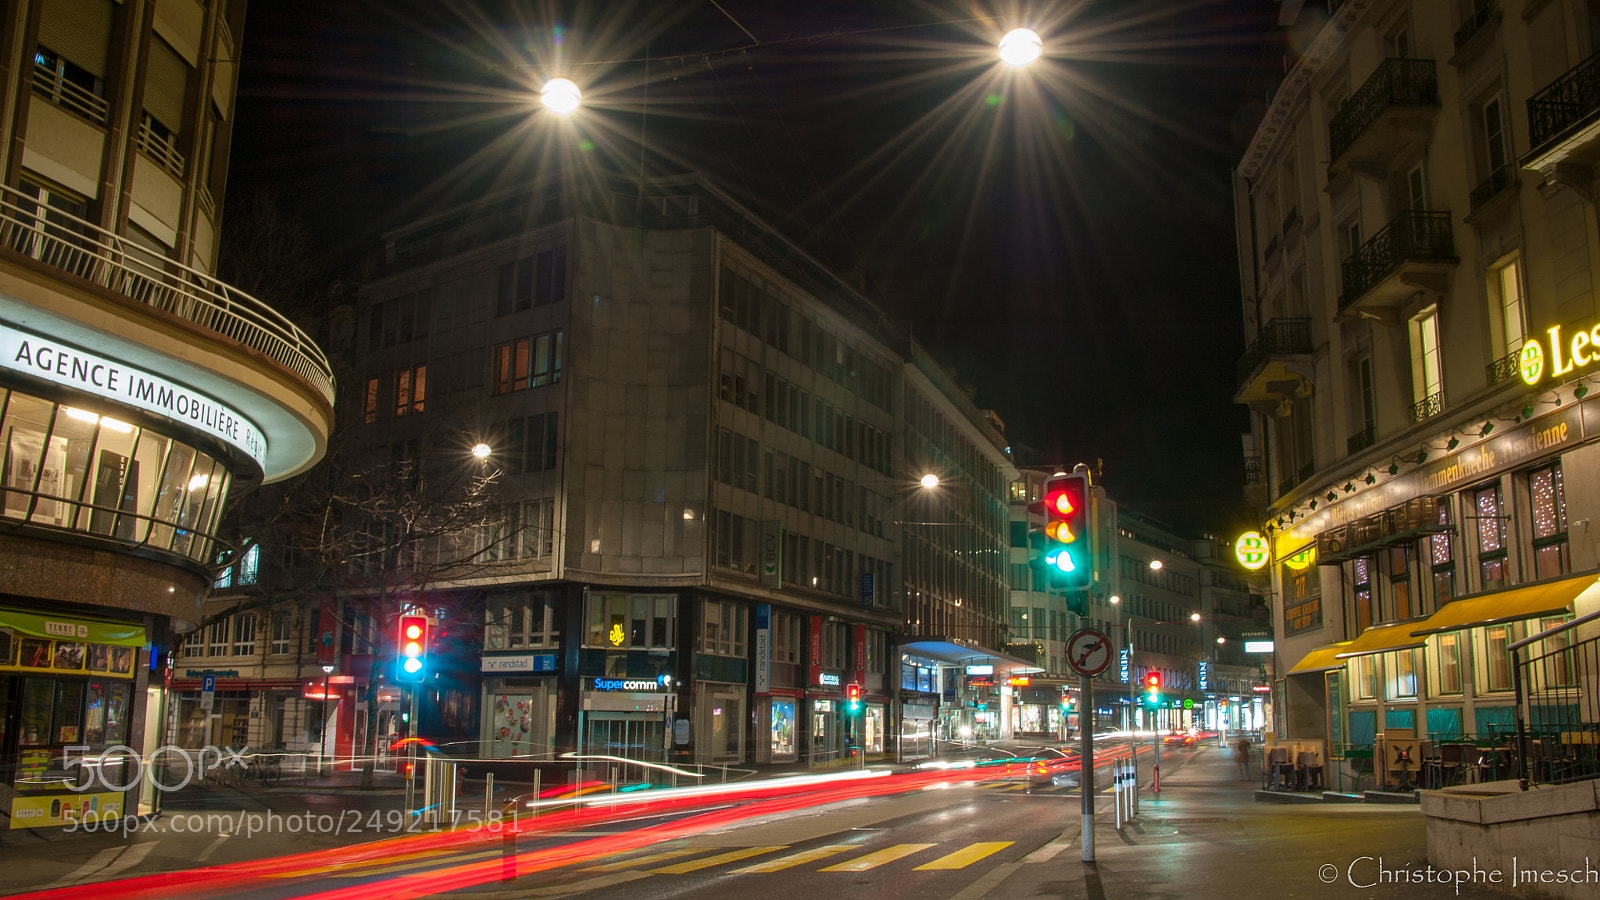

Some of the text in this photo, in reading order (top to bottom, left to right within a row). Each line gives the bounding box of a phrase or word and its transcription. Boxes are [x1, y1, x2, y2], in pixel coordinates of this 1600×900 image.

[15, 340, 119, 392] AGENCE
[128, 374, 239, 441] IMMOBILIÈRE
[1499, 421, 1569, 466] Alsacienne
[765, 532, 776, 562] BCV
[498, 658, 528, 669] randstad
[759, 634, 767, 672] randstad
[204, 677, 213, 691] P
[594, 677, 658, 692] Supercomm
